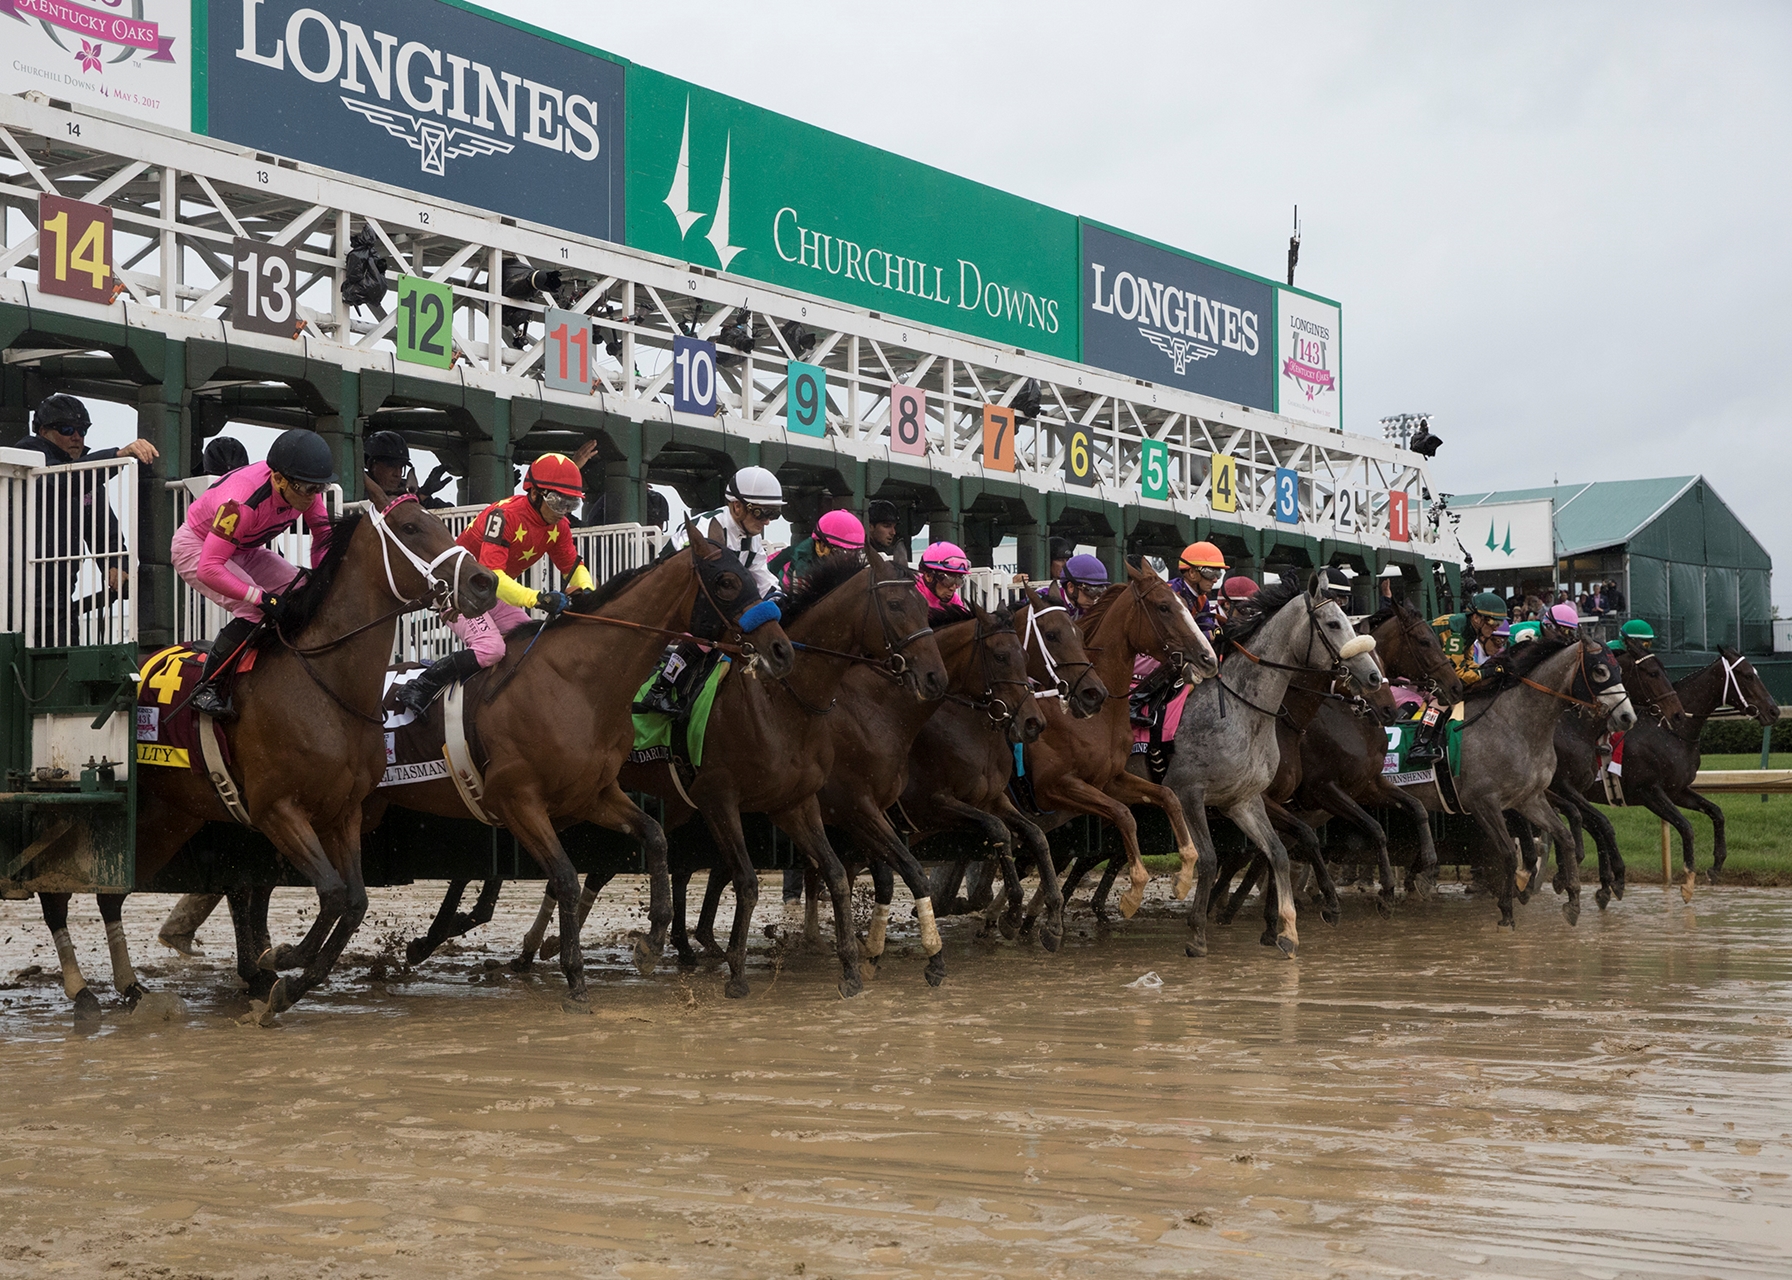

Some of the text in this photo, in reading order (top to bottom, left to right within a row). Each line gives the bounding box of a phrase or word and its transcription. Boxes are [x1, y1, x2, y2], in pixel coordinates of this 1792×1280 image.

[12, 60, 62, 83] CHURCHILL
[64, 74, 96, 92] DOWNS
[113, 88, 132, 101] MAY
[142, 97, 161, 109] 2017
[235, 0, 600, 161] LONGINES
[66, 121, 81, 137] 14
[256, 170, 269, 184] 13
[418, 212, 430, 225] 12
[43, 210, 111, 290] 14
[560, 248, 569, 259] 11
[237, 252, 293, 323] 13
[687, 279, 697, 291] 10
[773, 207, 1059, 334] CHURCHILL DOWNS
[400, 289, 445, 356] 12
[801, 306, 807, 317] 9
[1092, 262, 1259, 356] LONGINES
[902, 332, 908, 342] 8
[1290, 315, 1330, 340] LONGINES
[550, 323, 588, 383] 11
[994, 354, 999, 363] 7
[1299, 338, 1320, 365] 143
[675, 348, 714, 406] 10
[1078, 377, 1083, 386] 6
[795, 373, 818, 426] 9
[1152, 394, 1157, 403] 5
[898, 395, 918, 445] 8
[990, 413, 1008, 460] 7
[1070, 431, 1089, 478] 6
[1147, 448, 1164, 491] 5
[1216, 464, 1231, 504] 4
[1281, 476, 1294, 516] 3
[212, 505, 239, 535] 14
[1340, 489, 1351, 526] 2
[1395, 499, 1403, 535] 1
[484, 514, 503, 538] 13
[1449, 638, 1460, 652] 5
[137, 746, 174, 762] LTY
[395, 760, 447, 780] TASMAN
